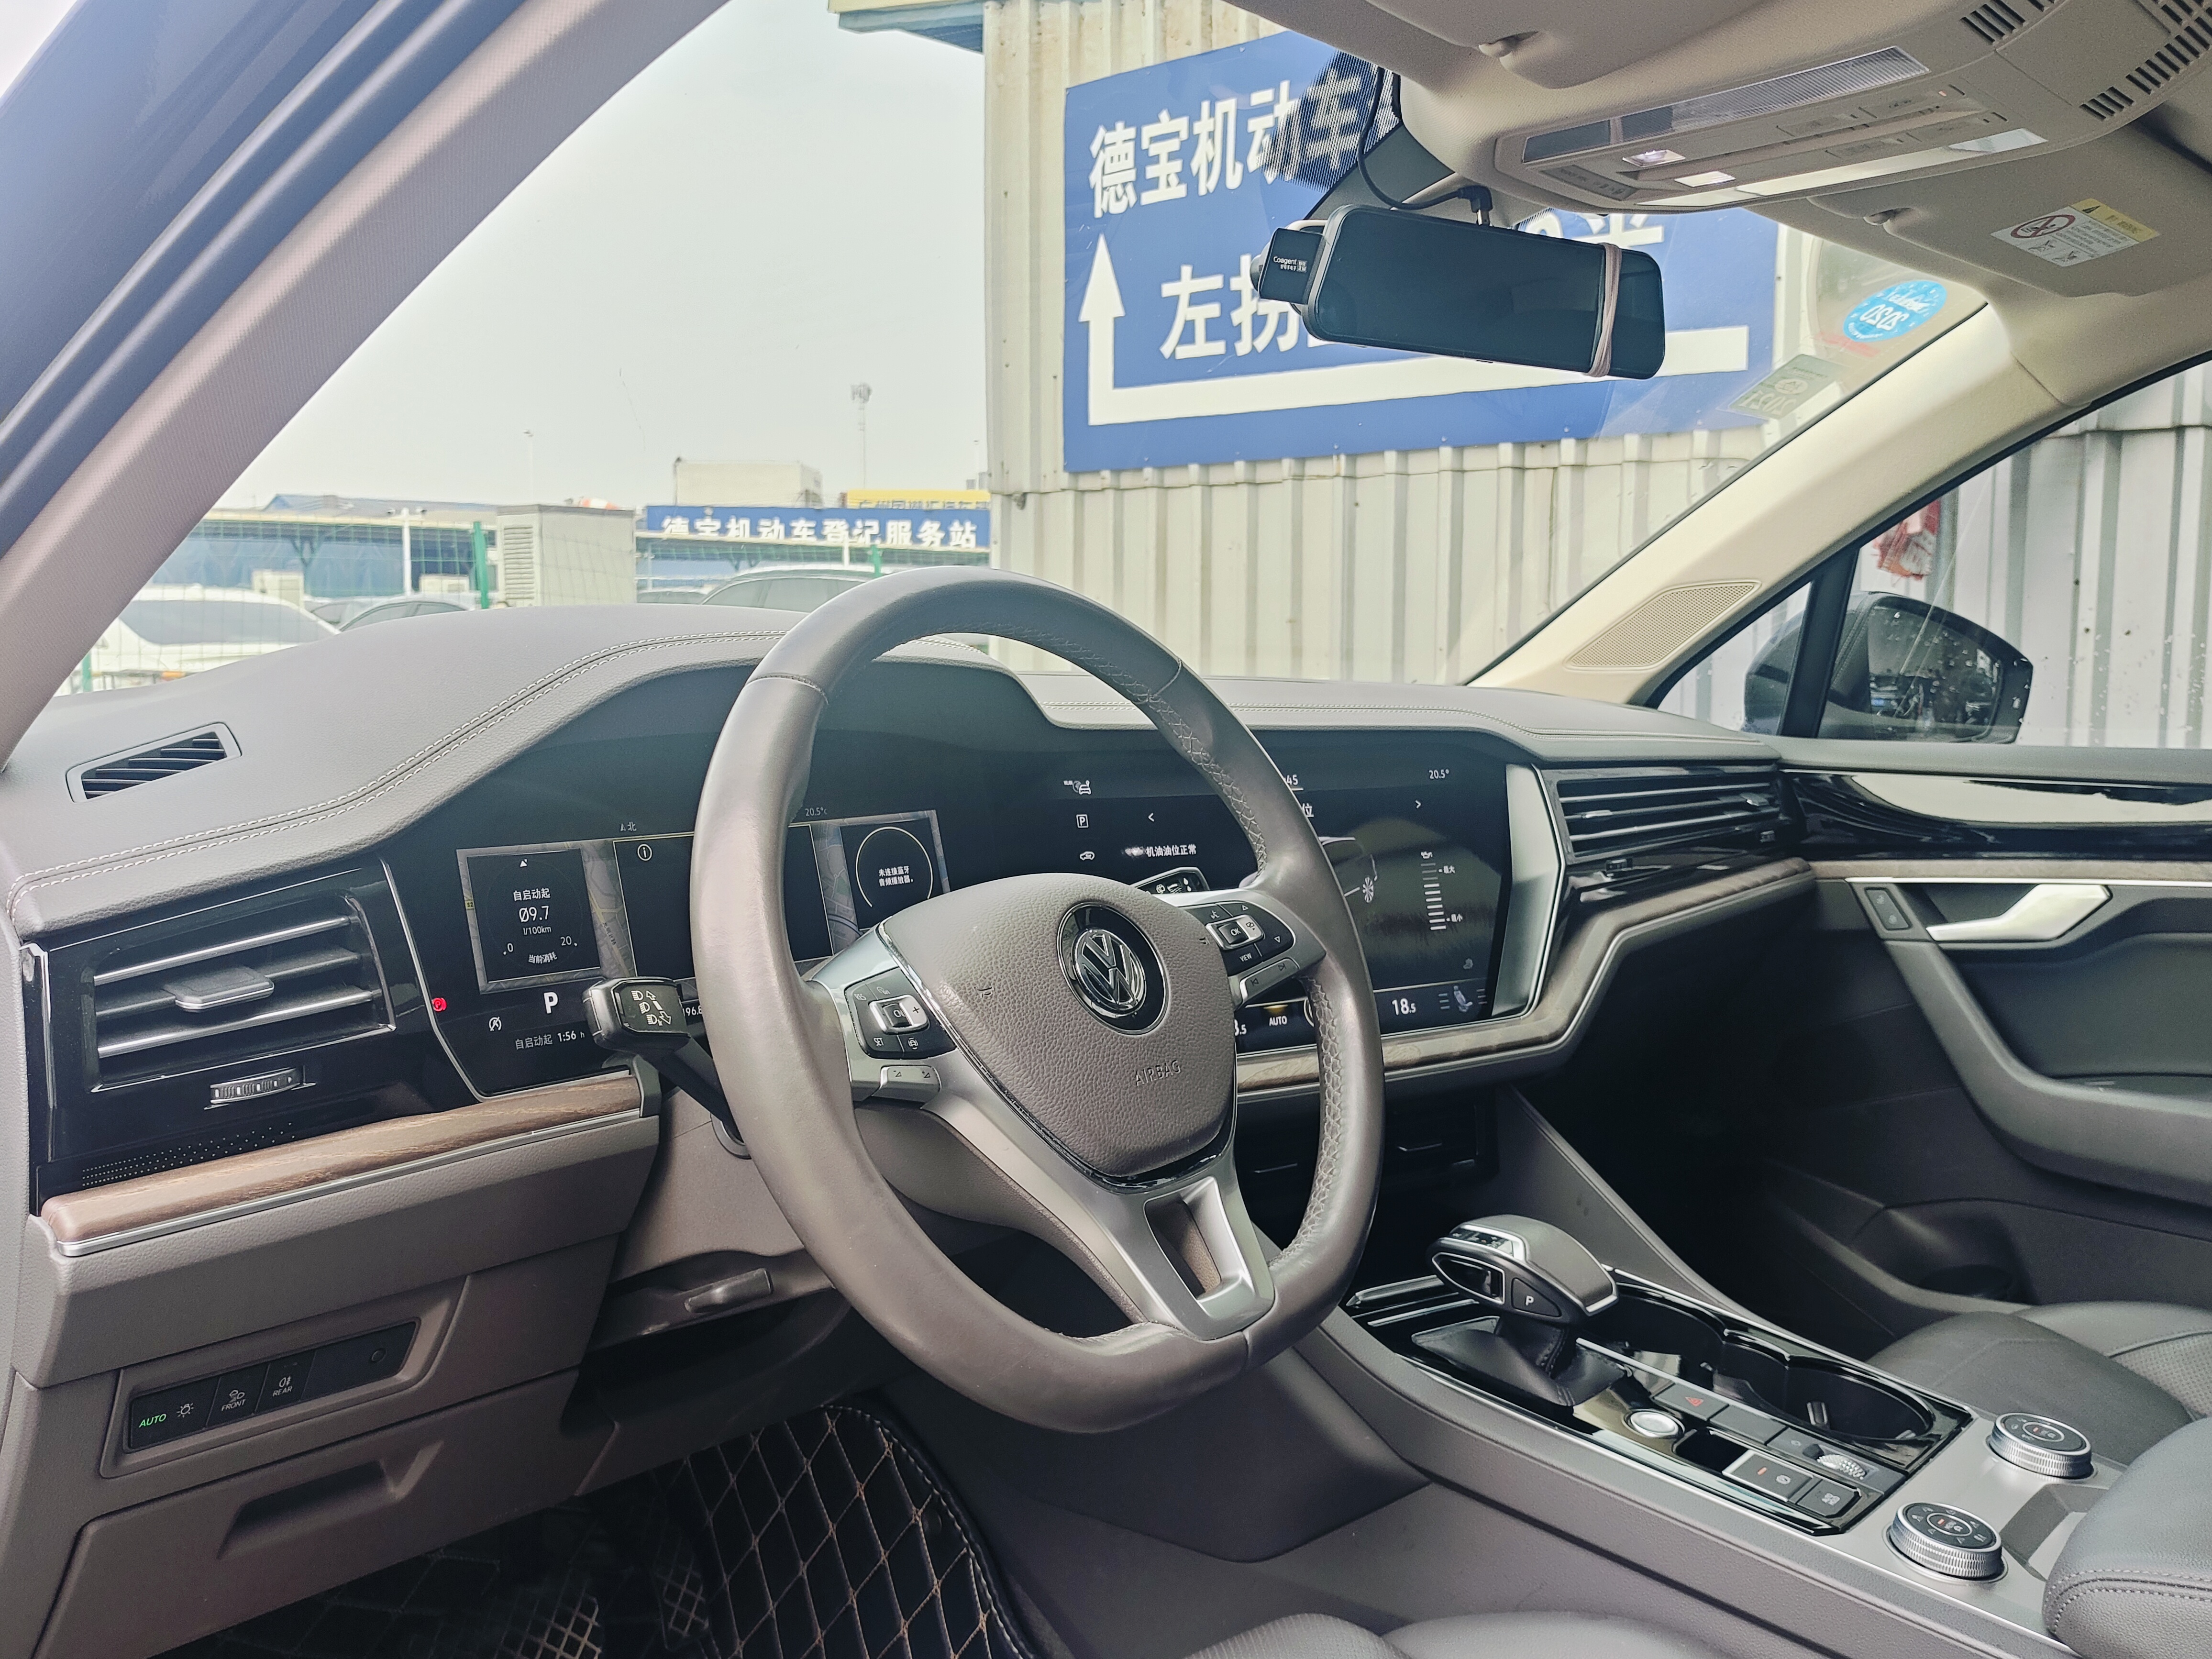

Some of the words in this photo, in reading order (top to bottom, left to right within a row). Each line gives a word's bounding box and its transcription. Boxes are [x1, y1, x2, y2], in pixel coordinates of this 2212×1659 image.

[1088, 68, 1400, 219] 德宝机动车
[1273, 256, 1297, 265] Coagent
[661, 515, 977, 549] 德宝机动车登记服务站
[1428, 769, 1449, 779] 20.5°
[627, 821, 637, 831] 北
[1146, 843, 1196, 857] 机油油位正常
[513, 887, 551, 902] 自启动起
[1230, 928, 1242, 936] OK
[560, 936, 572, 946] 20
[528, 951, 558, 964] 当前消耗
[1239, 952, 1252, 962] VIEW
[543, 992, 559, 1014] P
[1392, 998, 1416, 1016] 18.5
[1269, 1016, 1288, 1027] AUTO
[515, 1034, 553, 1051] 自启动起
[557, 1030, 577, 1043] 1:56
[873, 1037, 884, 1047] SET
[1135, 1060, 1182, 1087] AIRBAG
[1526, 1295, 1534, 1306] P
[273, 1386, 293, 1397] REAR
[221, 1399, 246, 1412] FRONT
[138, 1413, 167, 1428] AUTO
